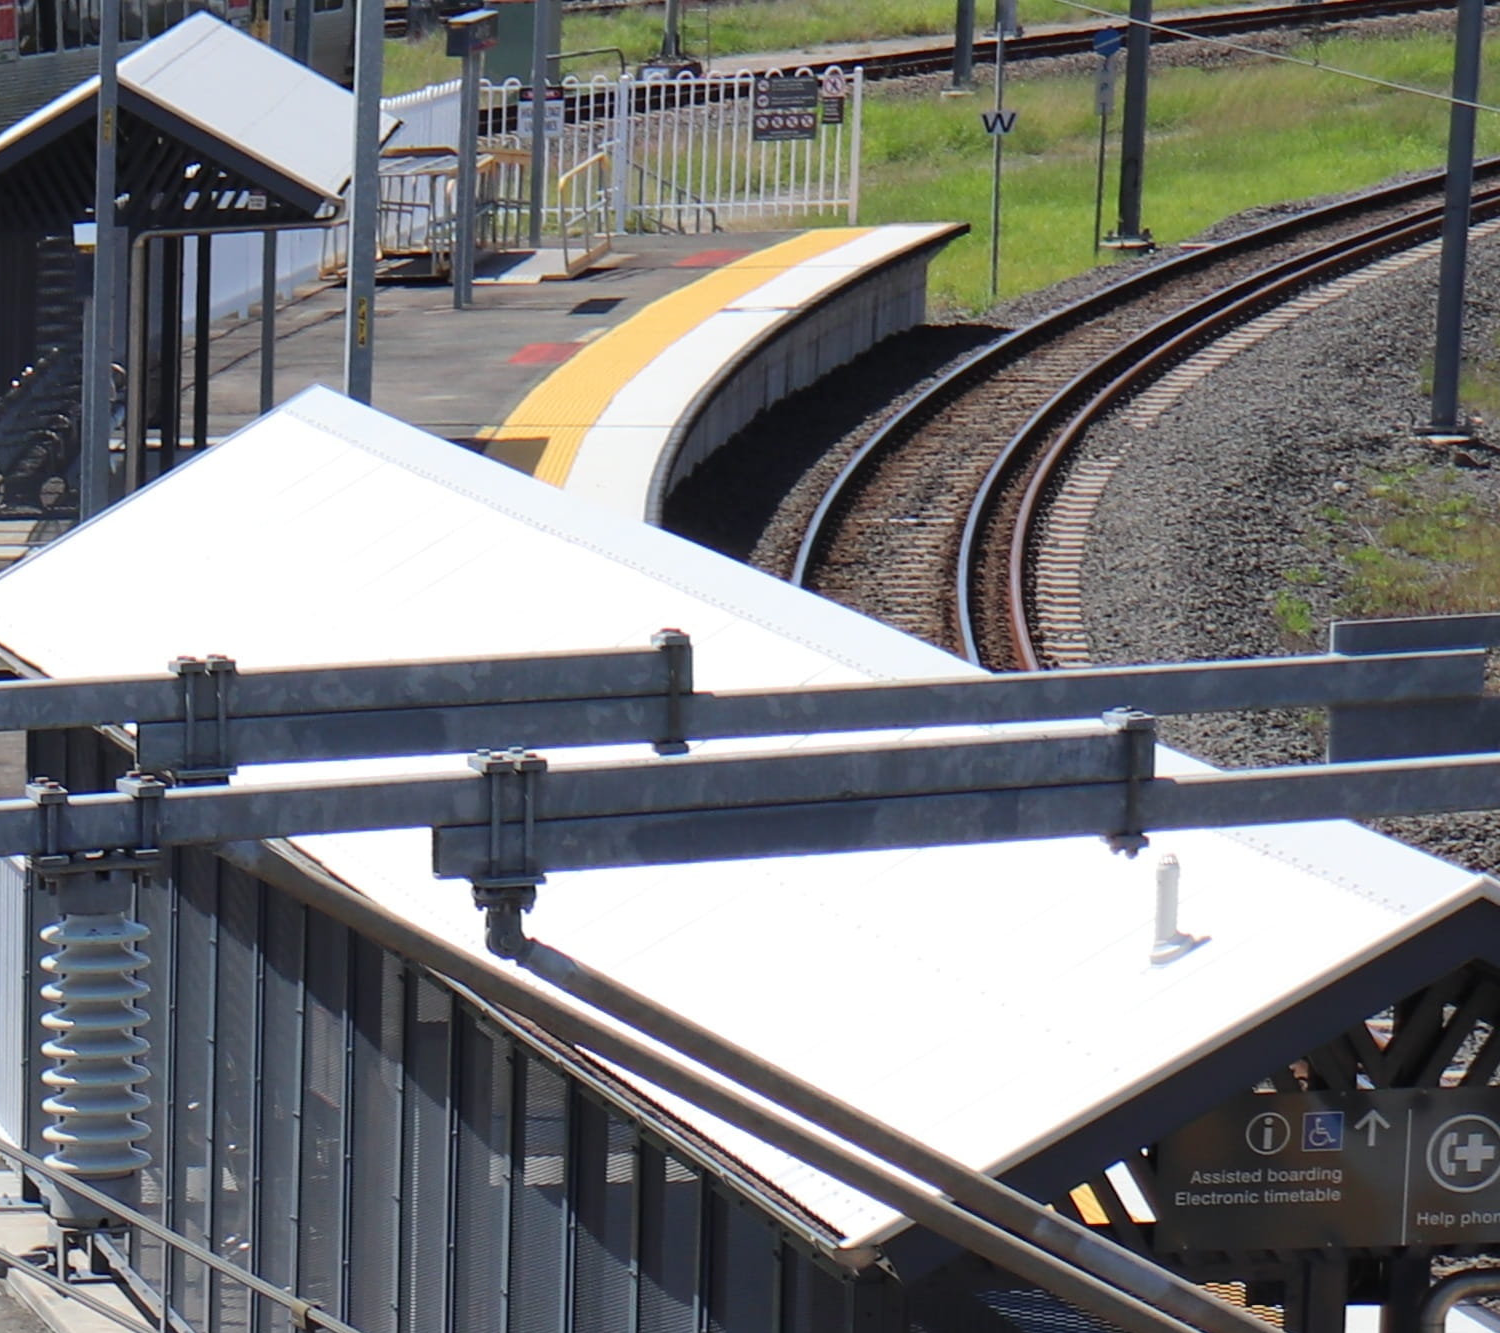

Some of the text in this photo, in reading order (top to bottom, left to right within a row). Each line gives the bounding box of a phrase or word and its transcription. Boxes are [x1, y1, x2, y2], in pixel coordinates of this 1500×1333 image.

[982, 112, 1017, 133] W
[1190, 1167, 1343, 1185] Assisted boarding
[1175, 1187, 1342, 1206] Electronic timetable
[1416, 1211, 1456, 1228] Help
